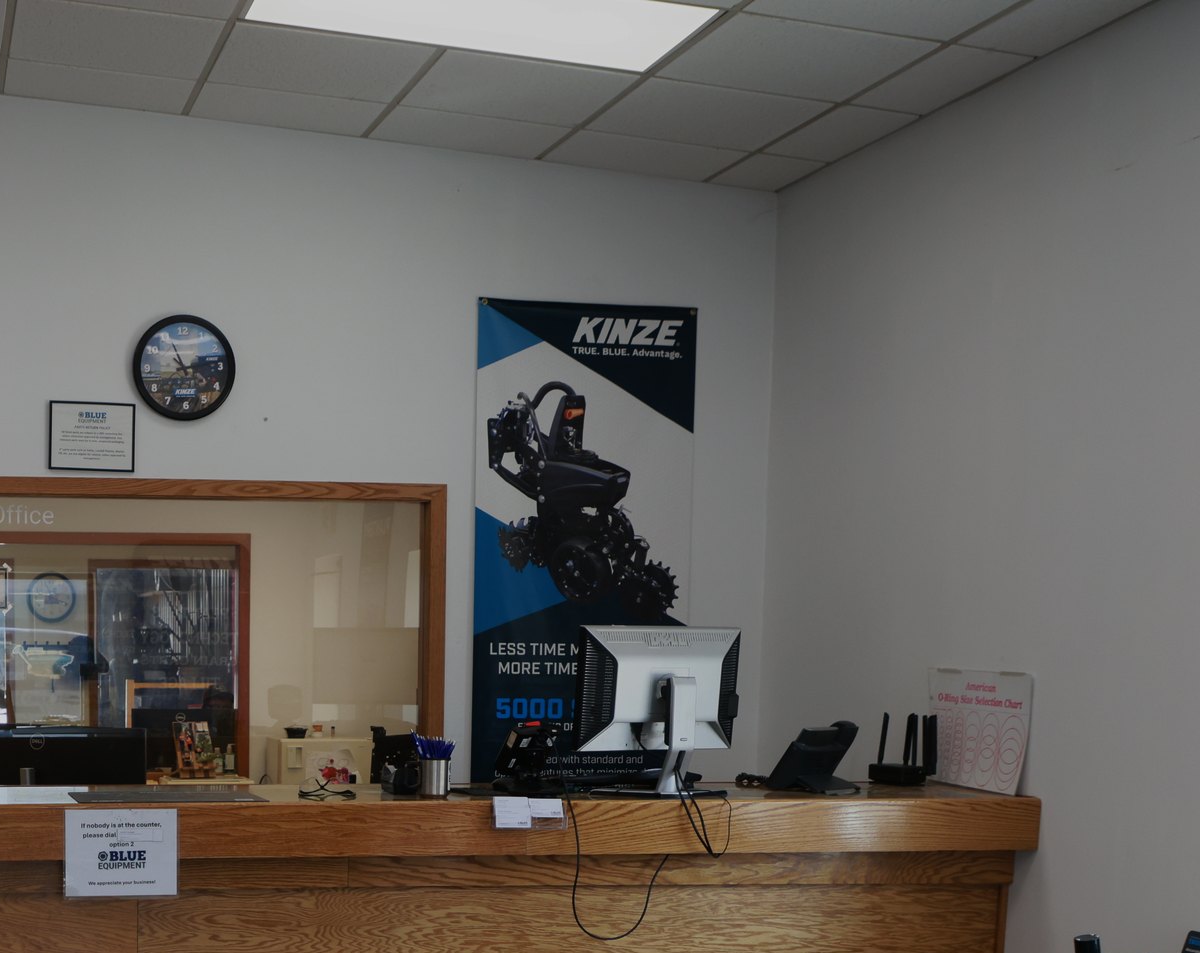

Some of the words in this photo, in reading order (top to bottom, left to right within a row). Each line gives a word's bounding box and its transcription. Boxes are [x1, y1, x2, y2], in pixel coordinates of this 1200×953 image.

[177, 327, 188, 335] 12
[572, 316, 684, 346] KINZE
[147, 346, 158, 354] 10
[572, 346, 600, 356] TRUE.
[602, 347, 630, 357] BLUE.
[632, 348, 683, 360] Advantage.
[217, 362, 223, 370] 3
[151, 384, 158, 392] 8
[213, 382, 220, 390] 4
[164, 397, 171, 405] 7
[201, 395, 207, 403] 5
[182, 401, 189, 409] 6
[84, 411, 107, 419] BLUE
[490, 643, 526, 656] LESS
[530, 643, 566, 656] TIME
[498, 661, 540, 675] MORE
[544, 661, 578, 675] TIME
[965, 682, 997, 693] American
[975, 696, 1003, 707] Selection
[1004, 698, 1023, 709] Chart
[496, 697, 564, 720] 5000
[560, 755, 580, 764] with
[582, 755, 624, 764] standard
[625, 755, 644, 764] and
[109, 850, 146, 861] BLUE
[98, 861, 146, 870] EQUIPMENT
